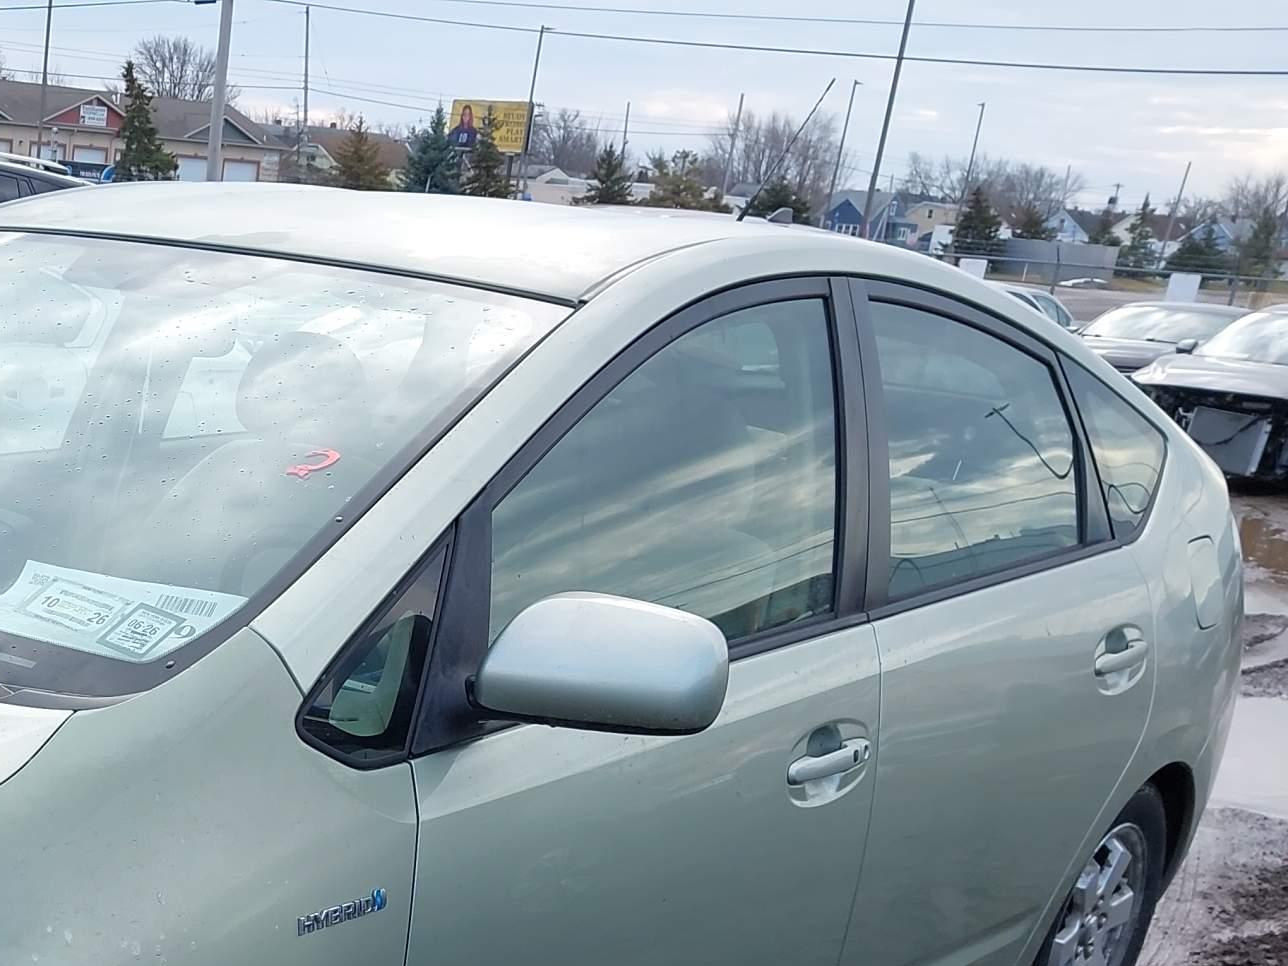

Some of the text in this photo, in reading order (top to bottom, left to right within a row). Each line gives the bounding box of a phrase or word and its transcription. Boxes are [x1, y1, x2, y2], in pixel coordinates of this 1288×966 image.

[41, 596, 60, 608] 10
[88, 612, 109, 624] 26
[297, 897, 373, 936] HYBRID
